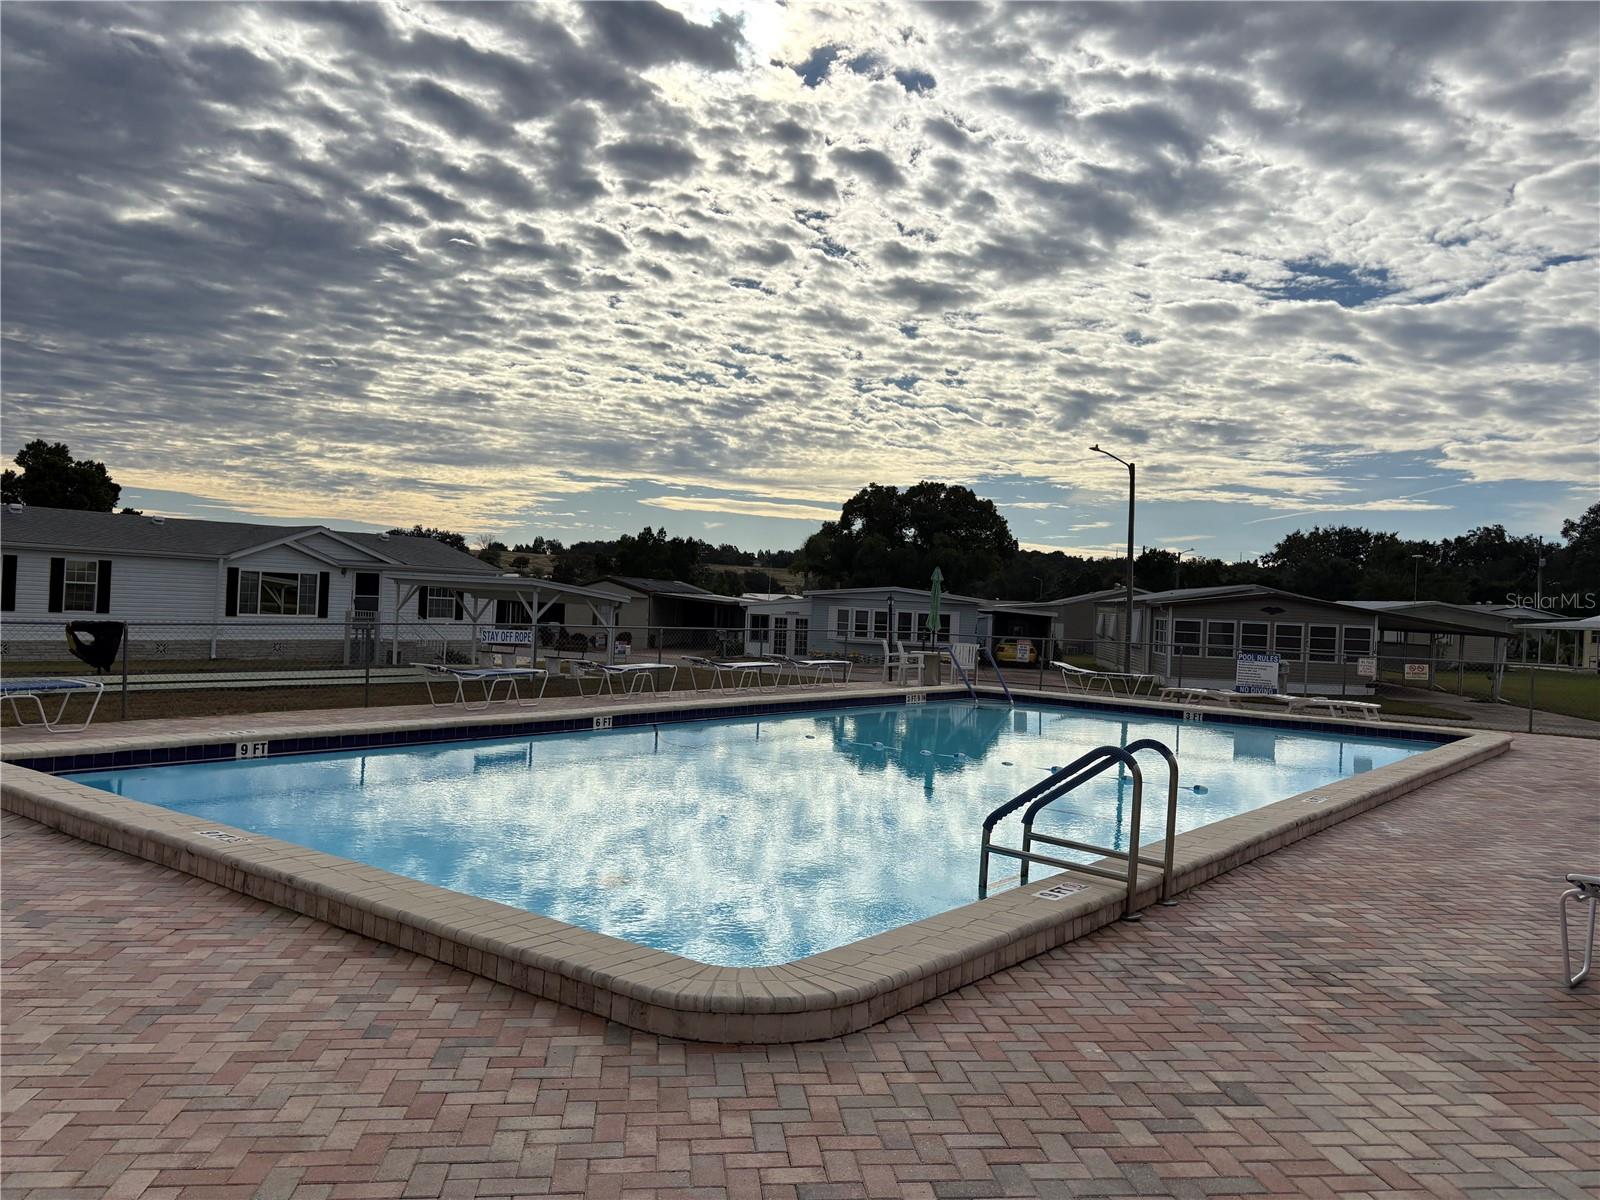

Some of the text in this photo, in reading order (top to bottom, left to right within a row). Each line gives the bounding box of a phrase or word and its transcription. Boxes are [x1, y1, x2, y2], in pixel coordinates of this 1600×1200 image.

[482, 630, 532, 642] STAY OFF ROPE
[1239, 653, 1279, 663] POOL RULES
[1250, 687, 1274, 695] DIVING
[1186, 712, 1202, 721] 3 FT
[595, 717, 612, 727] 6 FT
[241, 742, 268, 756] 9 FT
[1048, 886, 1075, 895] FT
